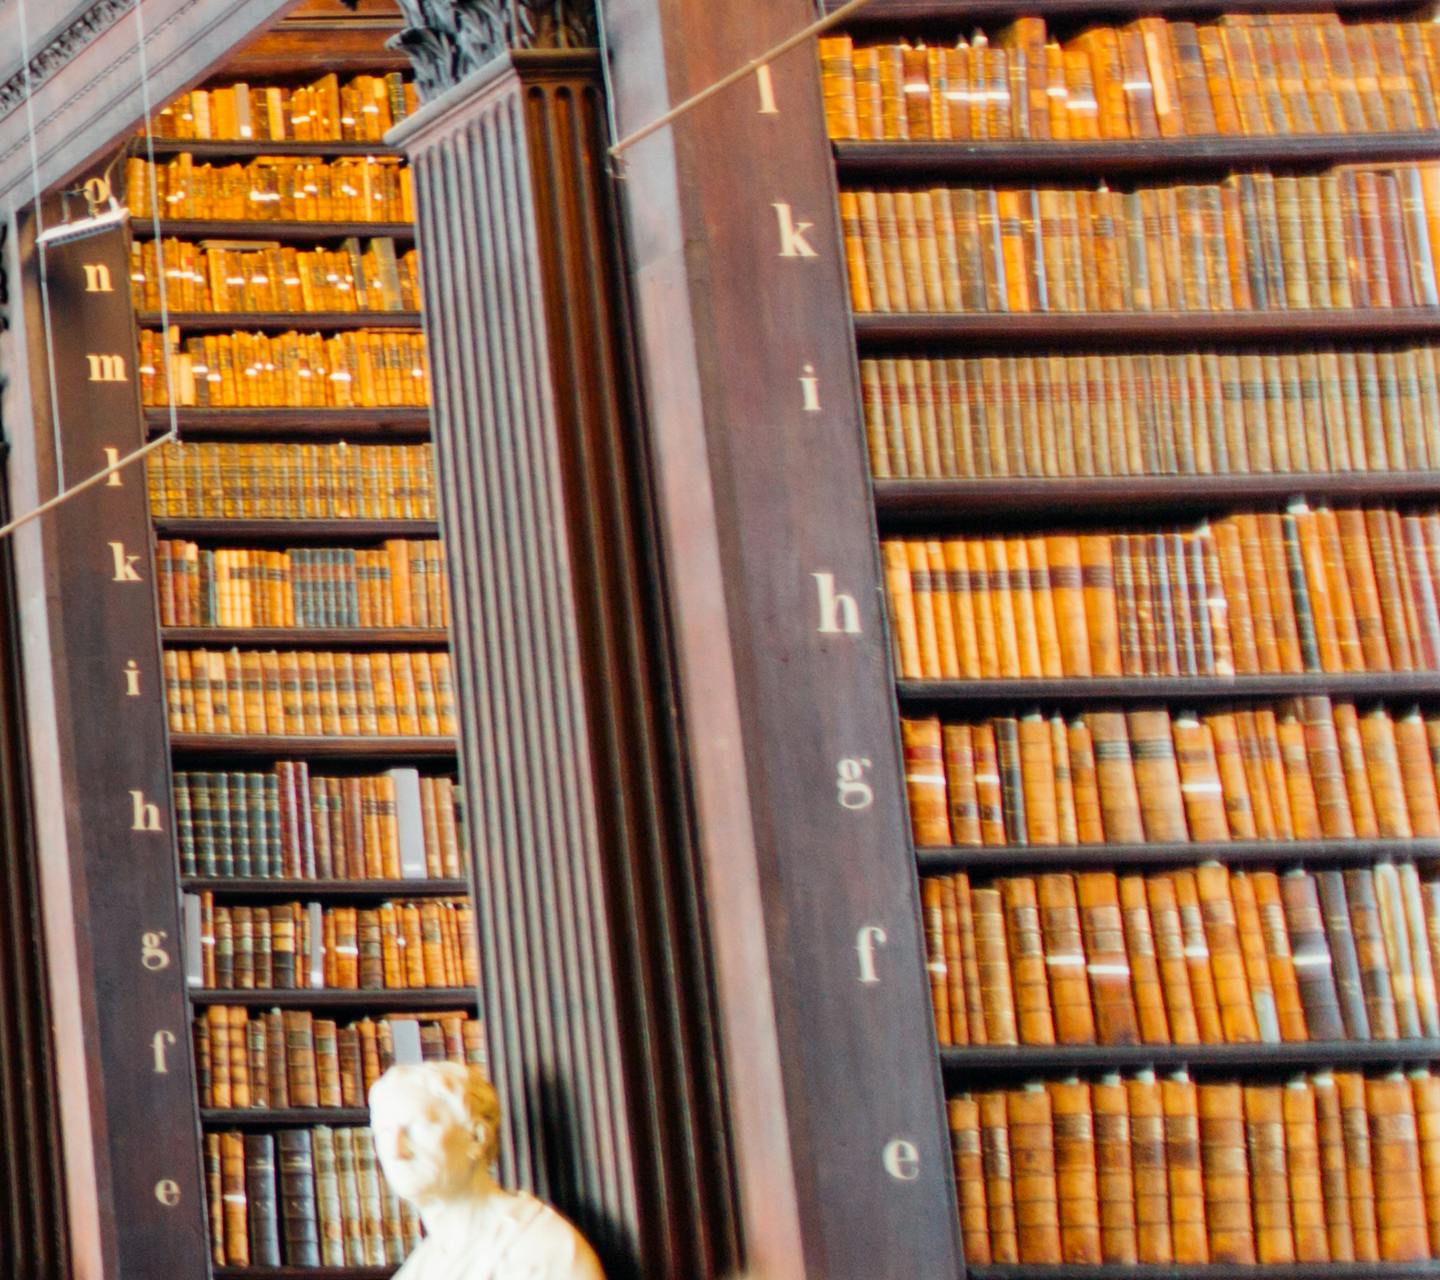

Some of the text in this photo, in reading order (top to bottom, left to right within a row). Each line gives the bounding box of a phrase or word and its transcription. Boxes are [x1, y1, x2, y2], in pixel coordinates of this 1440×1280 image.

[773, 203, 819, 258] k
[85, 262, 114, 292] n
[87, 353, 128, 381] m
[799, 365, 821, 411] i
[109, 542, 143, 582] k
[812, 573, 861, 634] h
[123, 661, 141, 696] i
[836, 757, 873, 809] g
[129, 790, 163, 832] h
[142, 931, 170, 971] g
[856, 926, 887, 983] f
[153, 1030, 176, 1073] f
[884, 1138, 920, 1180] e
[155, 1178, 180, 1207] e
